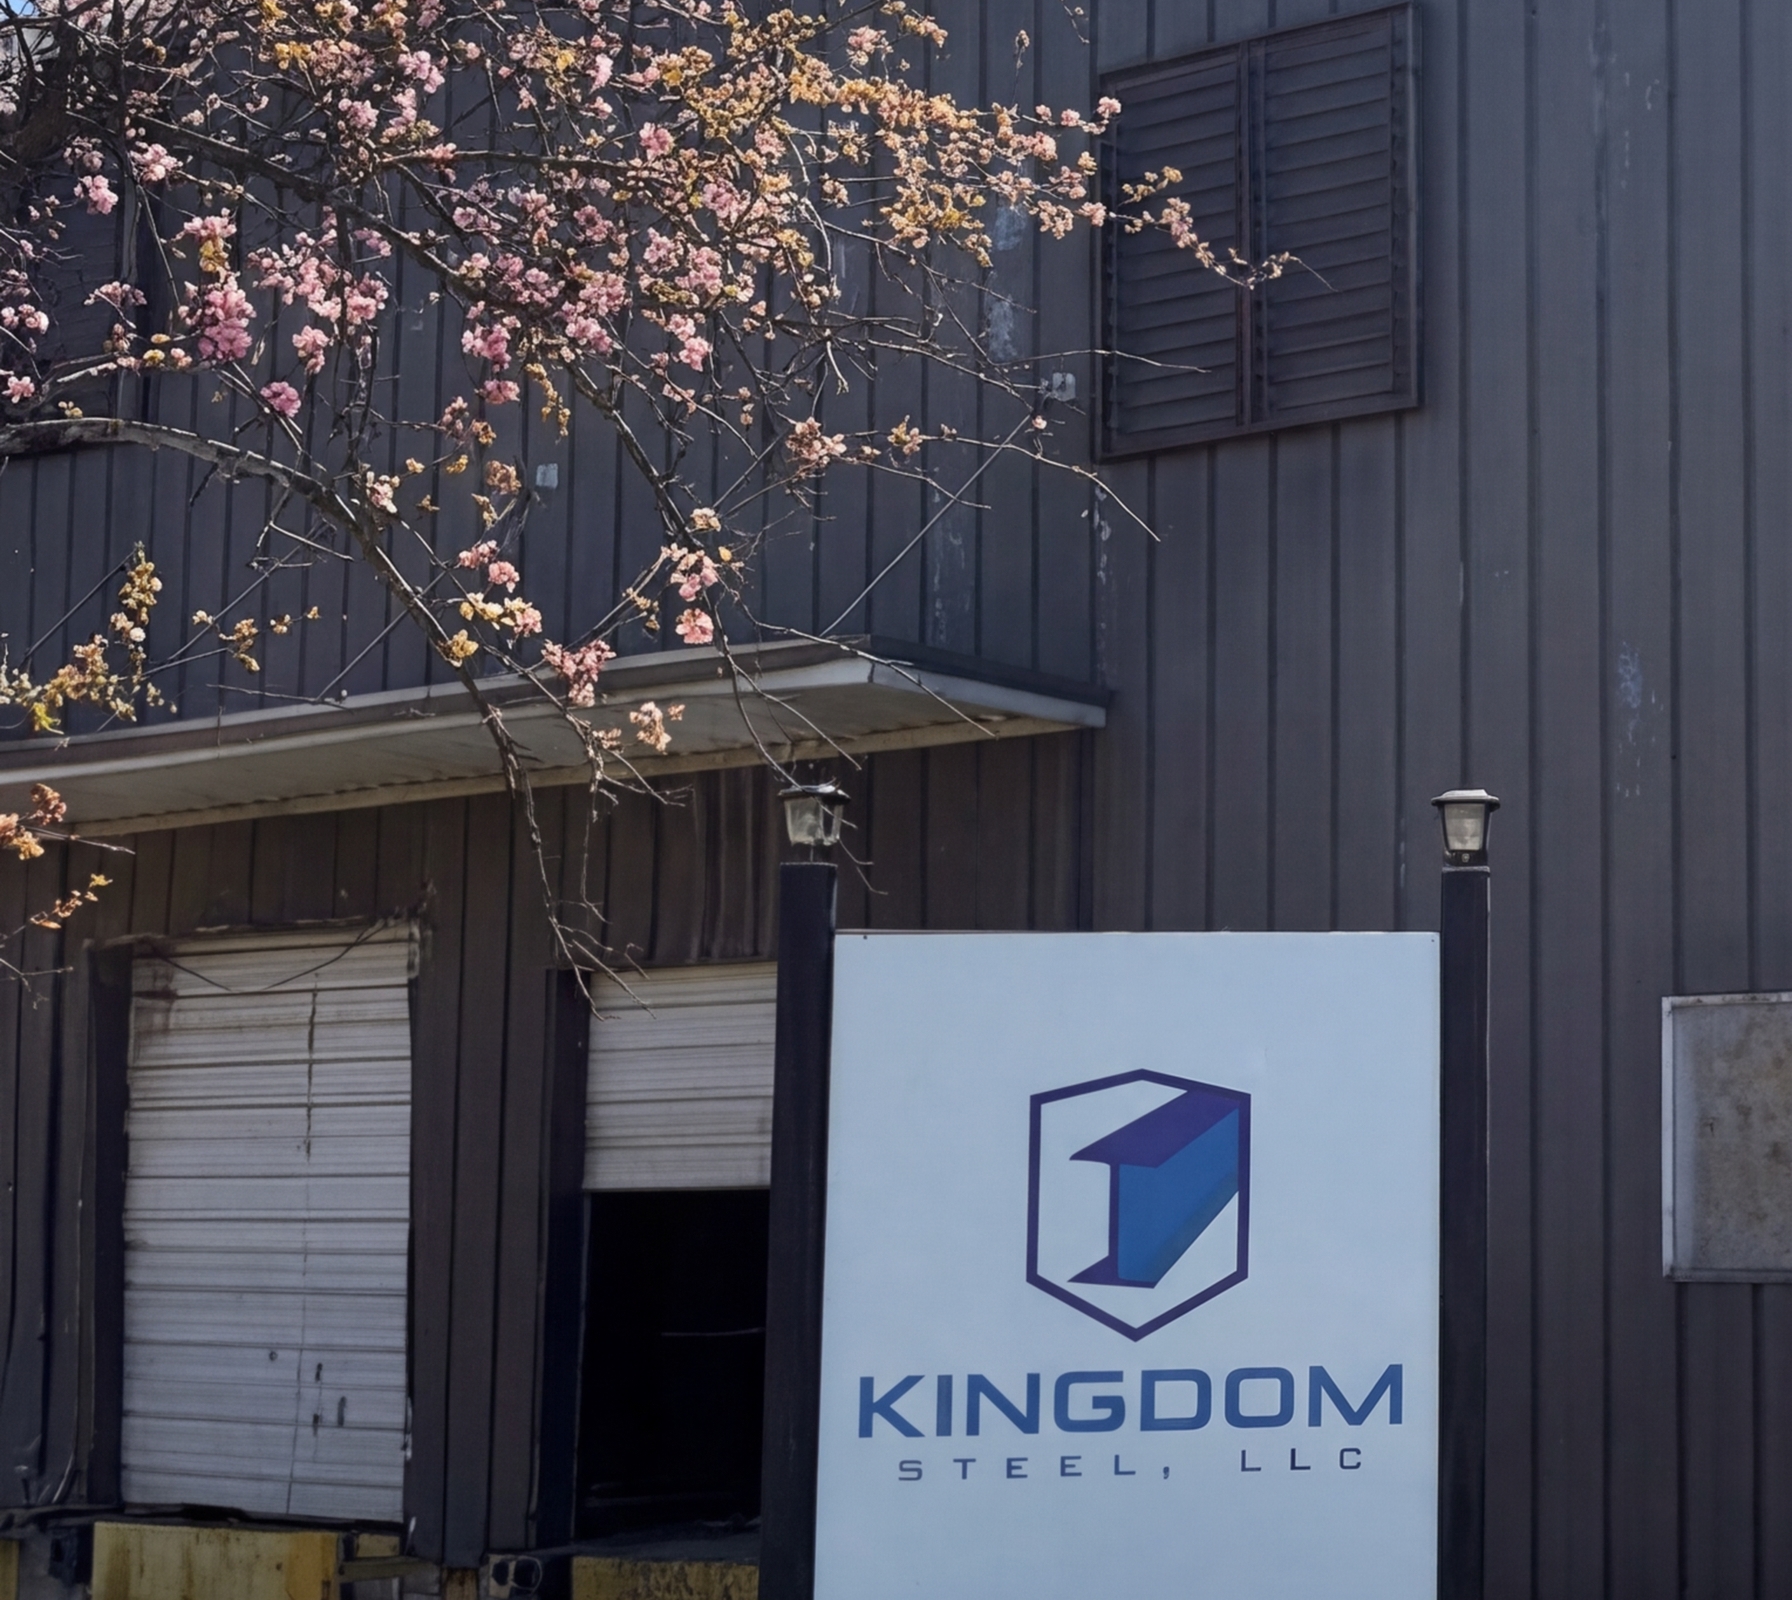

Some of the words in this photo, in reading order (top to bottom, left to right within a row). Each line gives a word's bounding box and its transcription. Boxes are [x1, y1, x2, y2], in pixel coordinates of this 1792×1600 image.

[858, 1363, 1403, 1438] KINGDOM
[898, 1454, 1171, 1481] STEEL,
[1240, 1447, 1363, 1472] LLC
